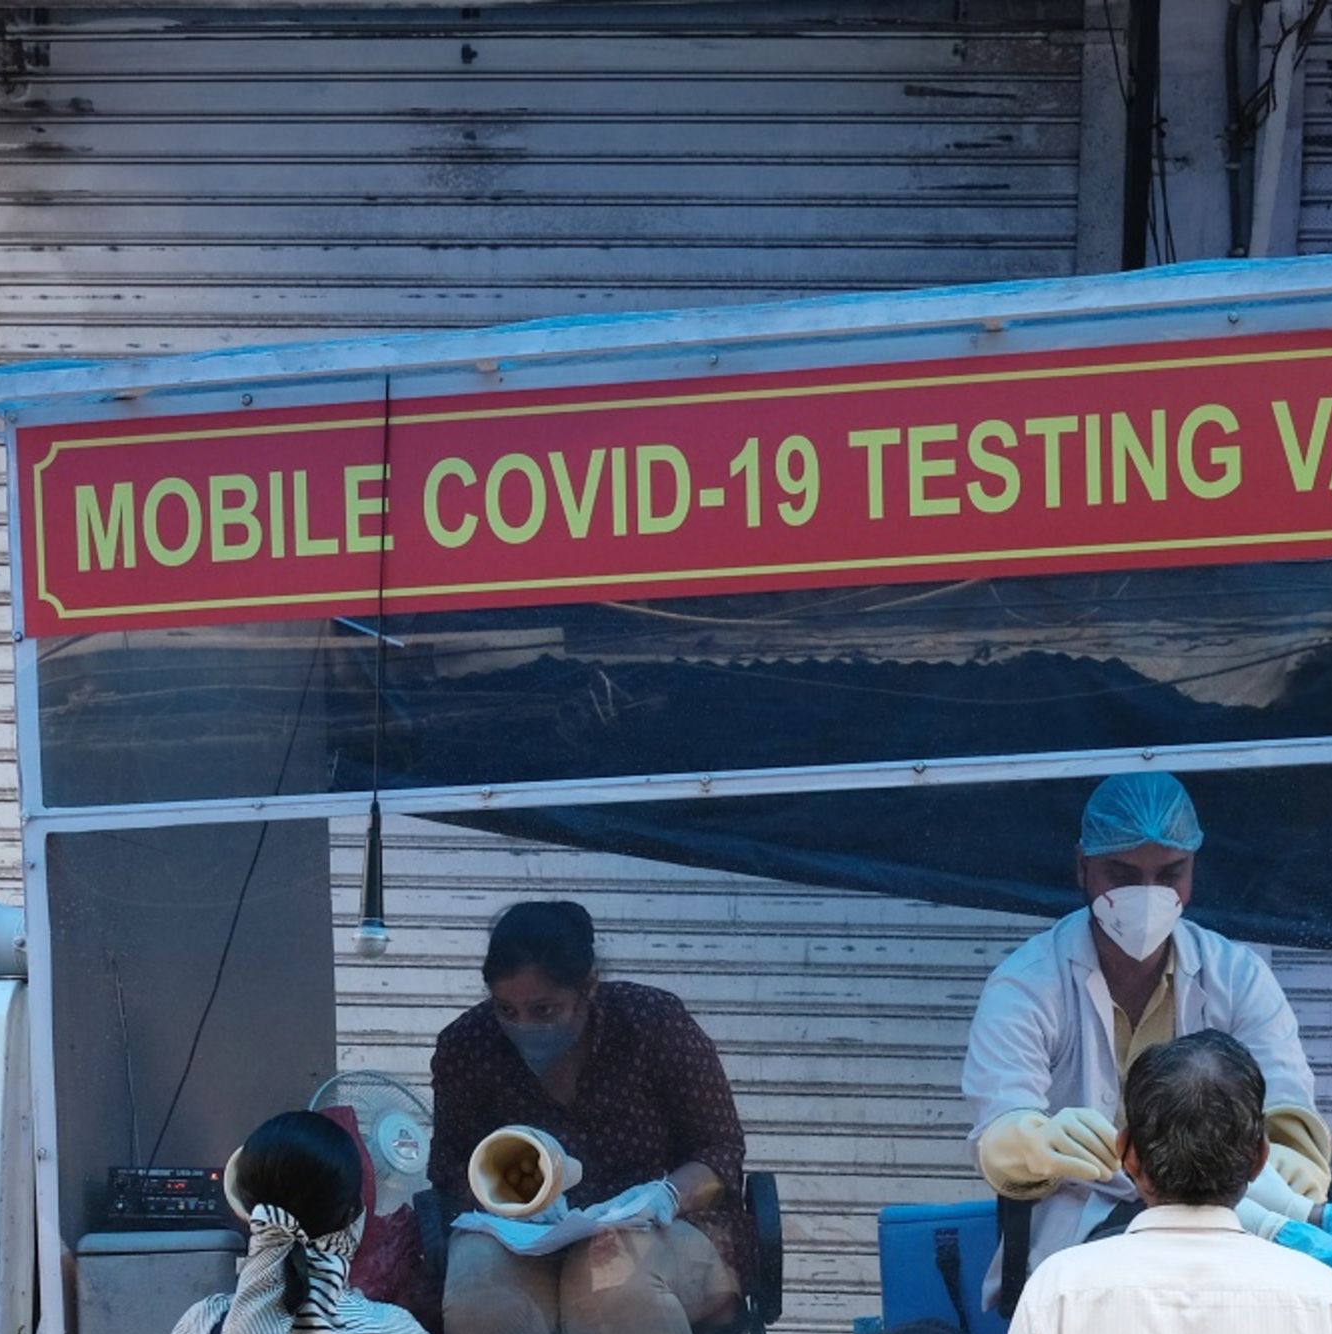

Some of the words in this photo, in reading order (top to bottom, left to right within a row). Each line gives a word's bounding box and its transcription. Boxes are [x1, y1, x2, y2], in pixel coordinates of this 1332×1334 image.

[73, 463, 395, 573] MOBILE
[422, 435, 821, 548] COVID-19
[848, 403, 1244, 520] TESTING
